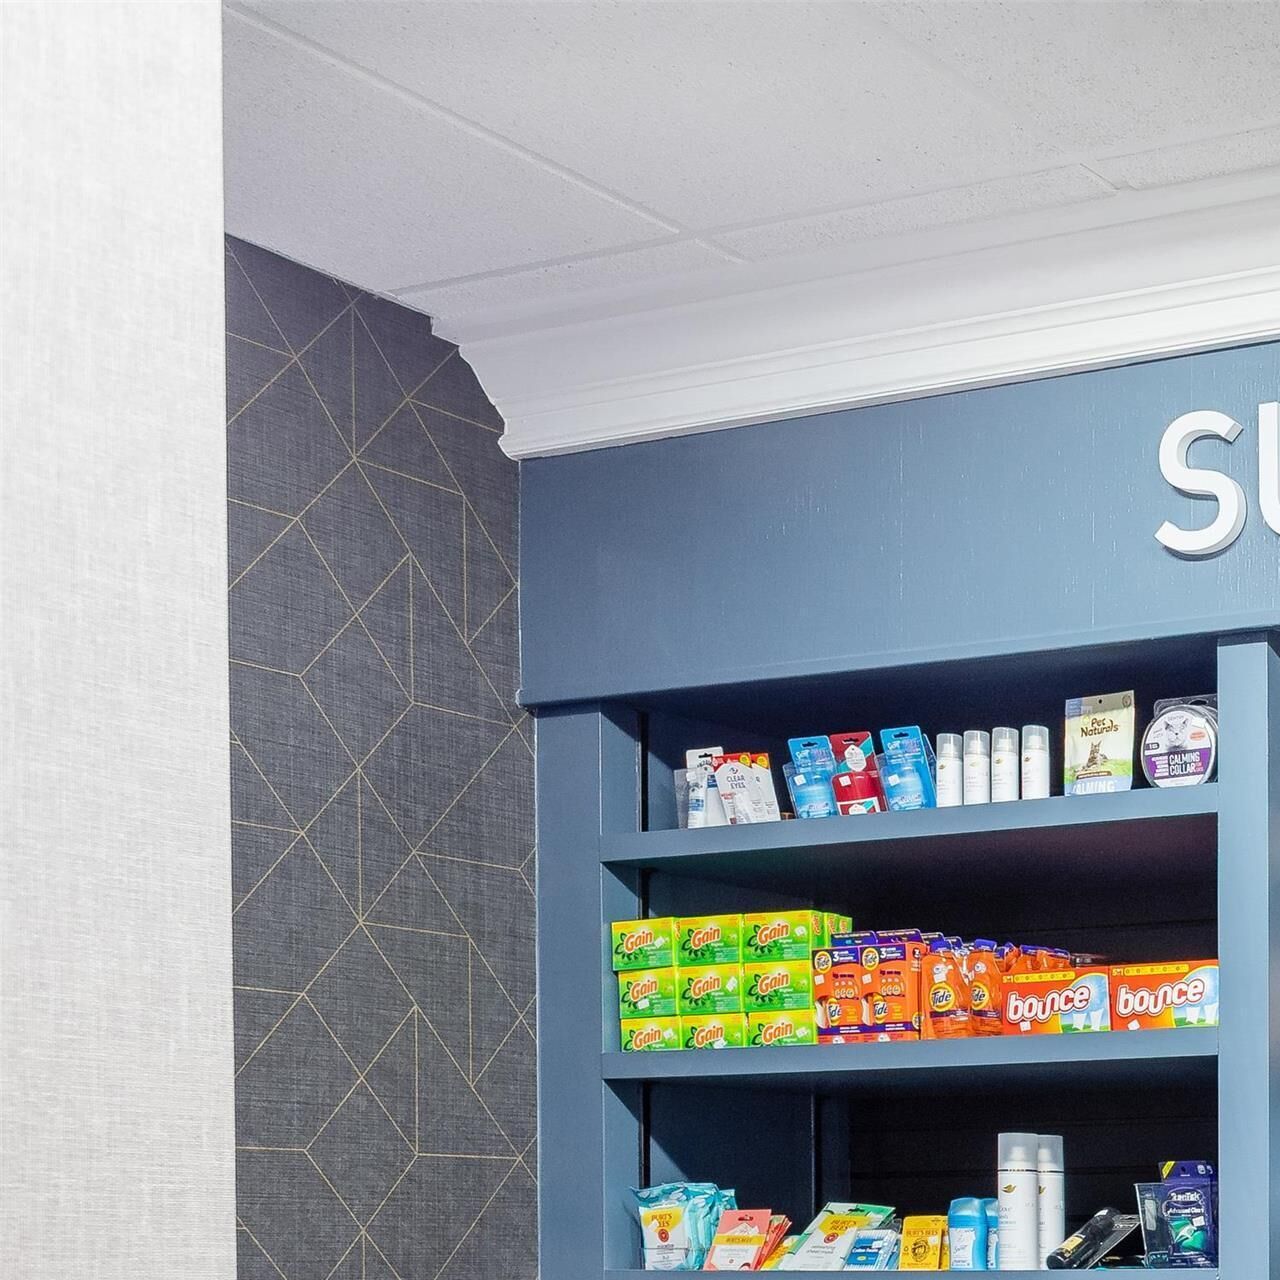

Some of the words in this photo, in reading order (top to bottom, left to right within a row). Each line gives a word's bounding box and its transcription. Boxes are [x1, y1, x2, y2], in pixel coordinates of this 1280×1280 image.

[1080, 719, 1119, 738] Naturals
[1091, 717, 1106, 726] Pet
[1169, 752, 1200, 765] CALMING
[1169, 764, 1196, 776] COLLAR
[726, 775, 746, 783] CLEAR
[624, 930, 654, 954] Gain
[690, 926, 721, 950] Gain
[756, 923, 790, 947] Gain
[629, 979, 658, 1002] Gain
[690, 976, 721, 1000] Gain
[758, 972, 789, 995] Gain
[1006, 985, 1092, 1021] bounce
[1118, 978, 1206, 1017] bounce
[632, 1026, 661, 1050] Gain
[694, 1024, 724, 1048] Gain
[761, 1022, 793, 1045] Gain
